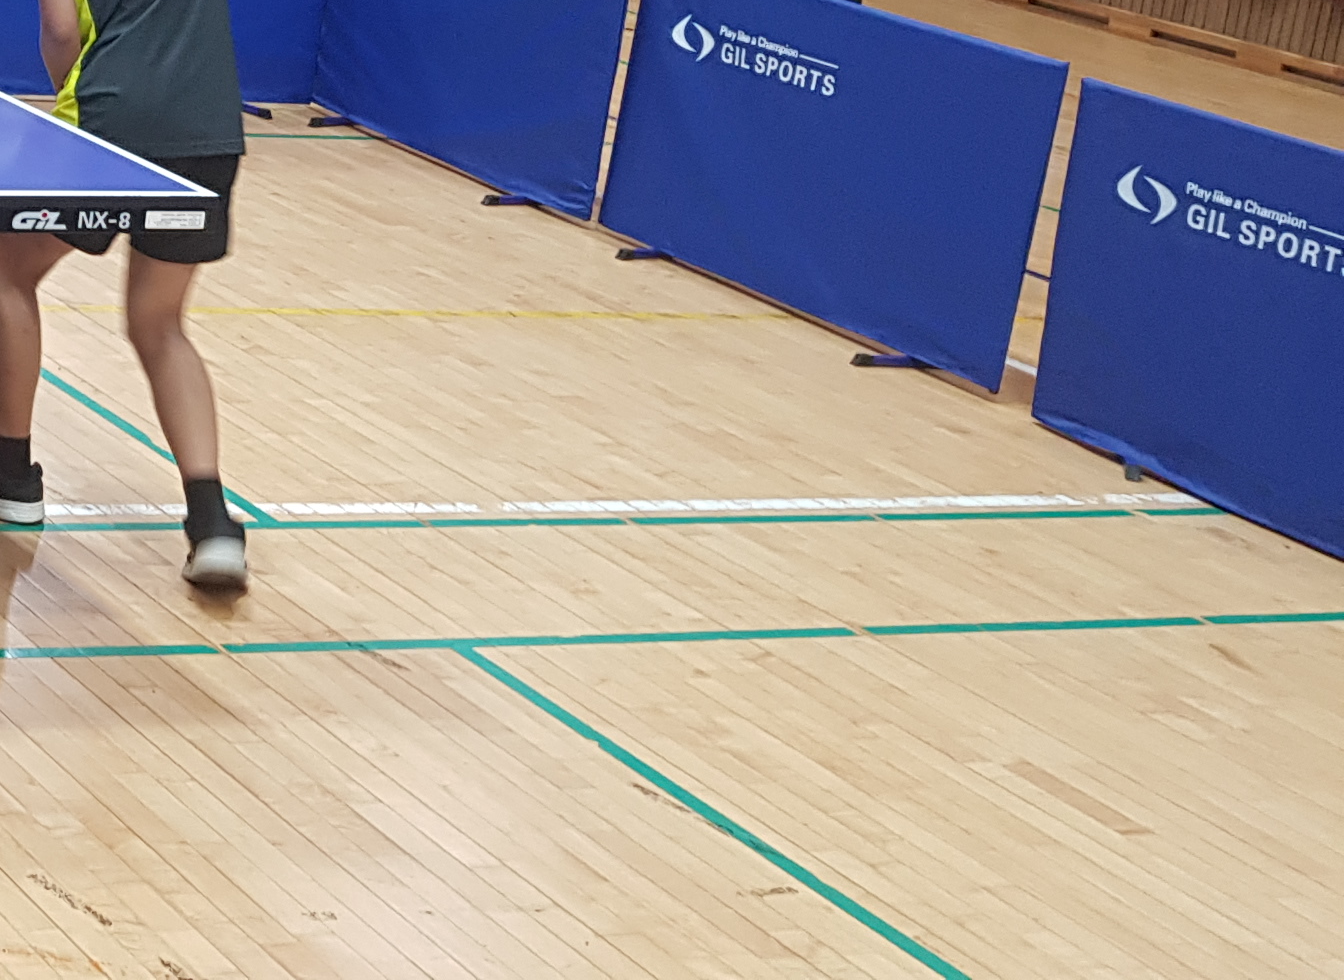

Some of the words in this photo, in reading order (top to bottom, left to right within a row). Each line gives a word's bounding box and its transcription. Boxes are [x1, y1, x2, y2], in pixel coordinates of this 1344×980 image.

[720, 42, 750, 70] GIL
[754, 52, 836, 97] SPORTS
[77, 210, 131, 230] NX-8
[1185, 181, 1212, 203] Play
[1212, 189, 1233, 207] like
[1233, 198, 1243, 210] a
[1243, 199, 1307, 230] Champion
[1186, 203, 1231, 240] GIL
[1238, 219, 1344, 277] SPORT
